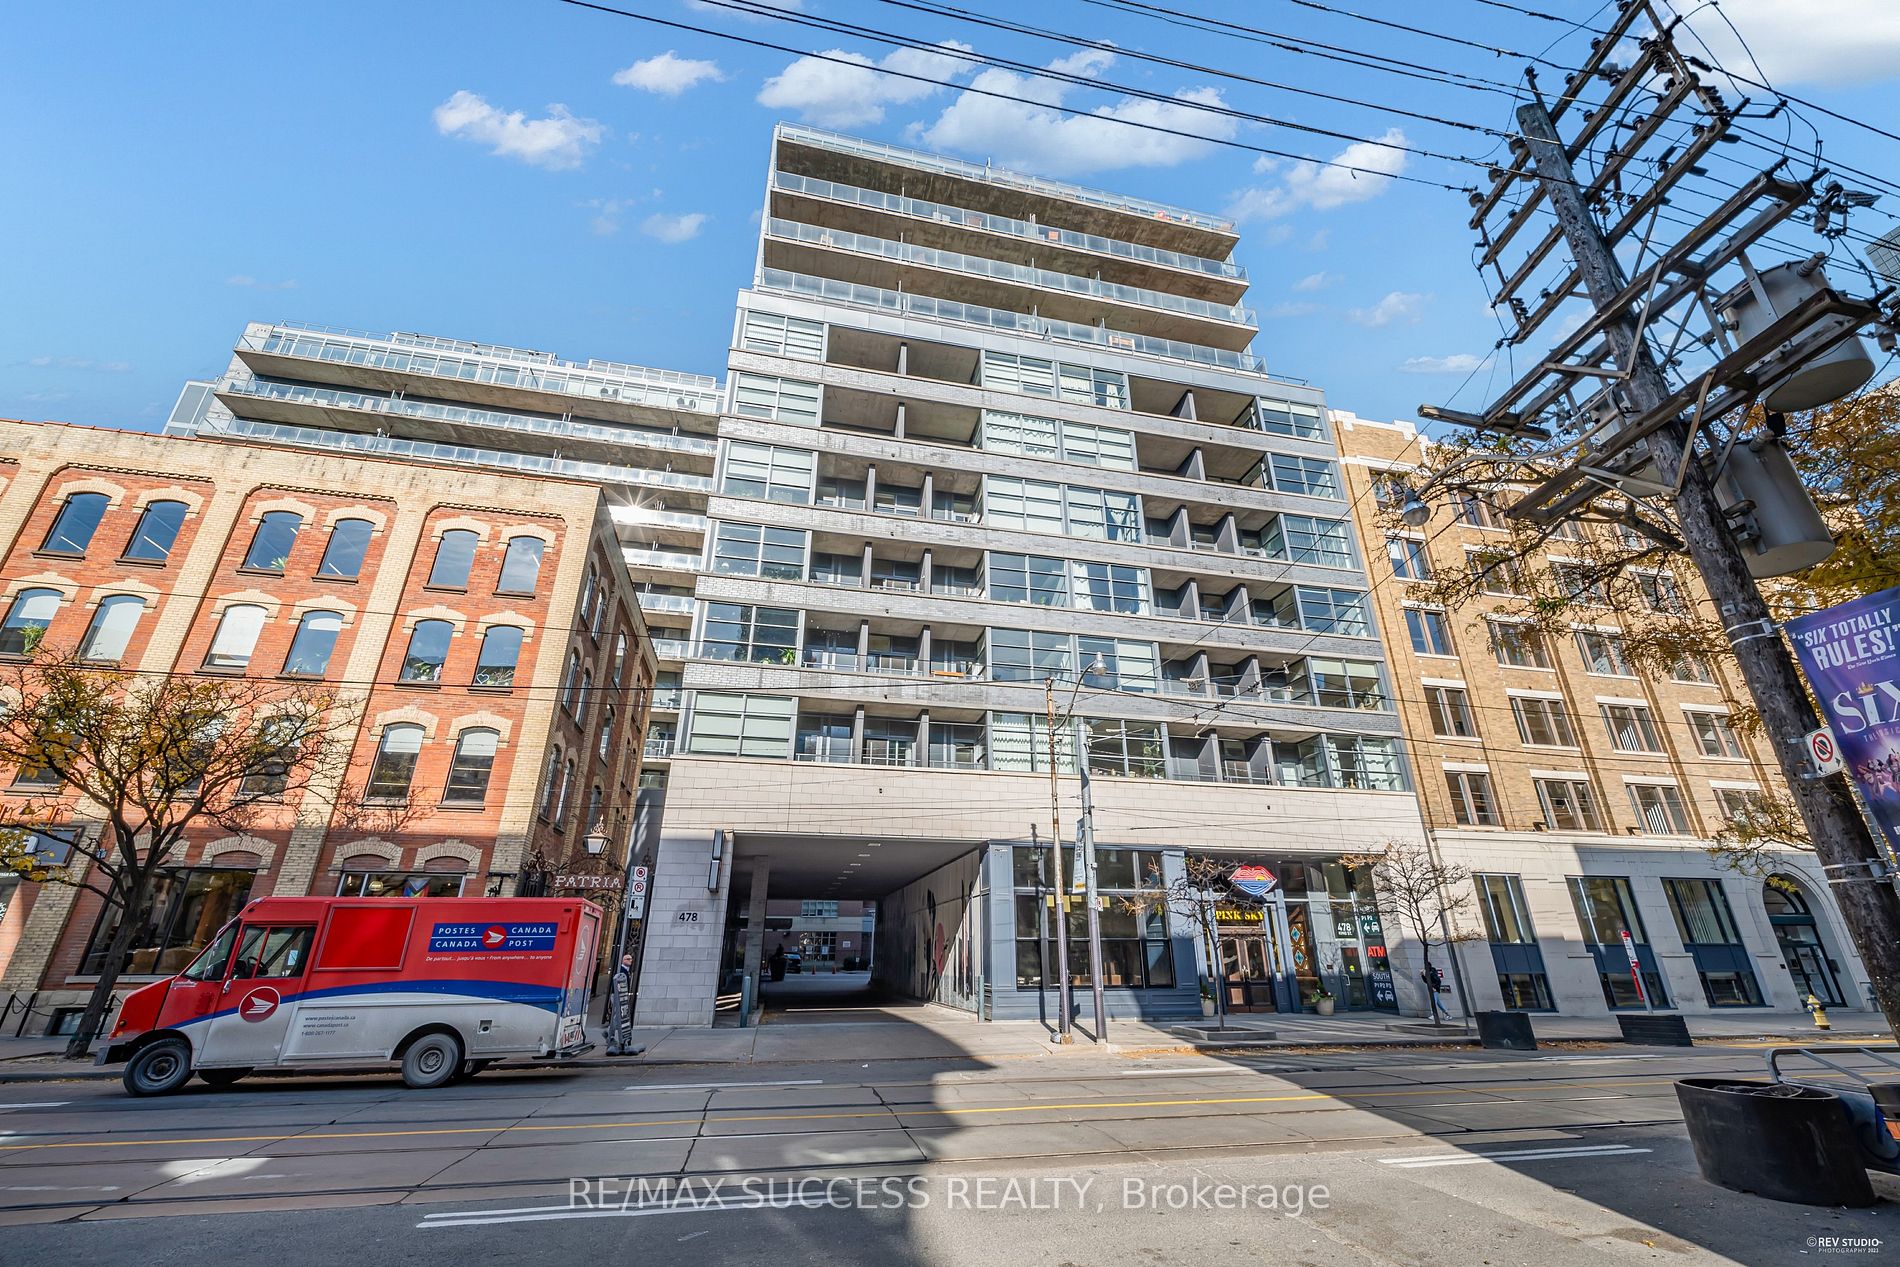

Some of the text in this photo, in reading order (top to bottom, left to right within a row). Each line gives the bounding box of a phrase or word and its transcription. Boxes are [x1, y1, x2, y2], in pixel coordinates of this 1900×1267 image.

[1829, 607, 1891, 639] TOTALLY
[554, 875, 622, 888] PATRIA
[679, 912, 698, 922] 478
[1216, 910, 1264, 920] PINK SKY
[511, 926, 552, 934] CANADA
[1337, 922, 1351, 932] 478
[435, 940, 478, 948] CANADA
[508, 939, 534, 947] POST
[1367, 946, 1386, 957] ATM
[1372, 972, 1391, 980] SOUTH
